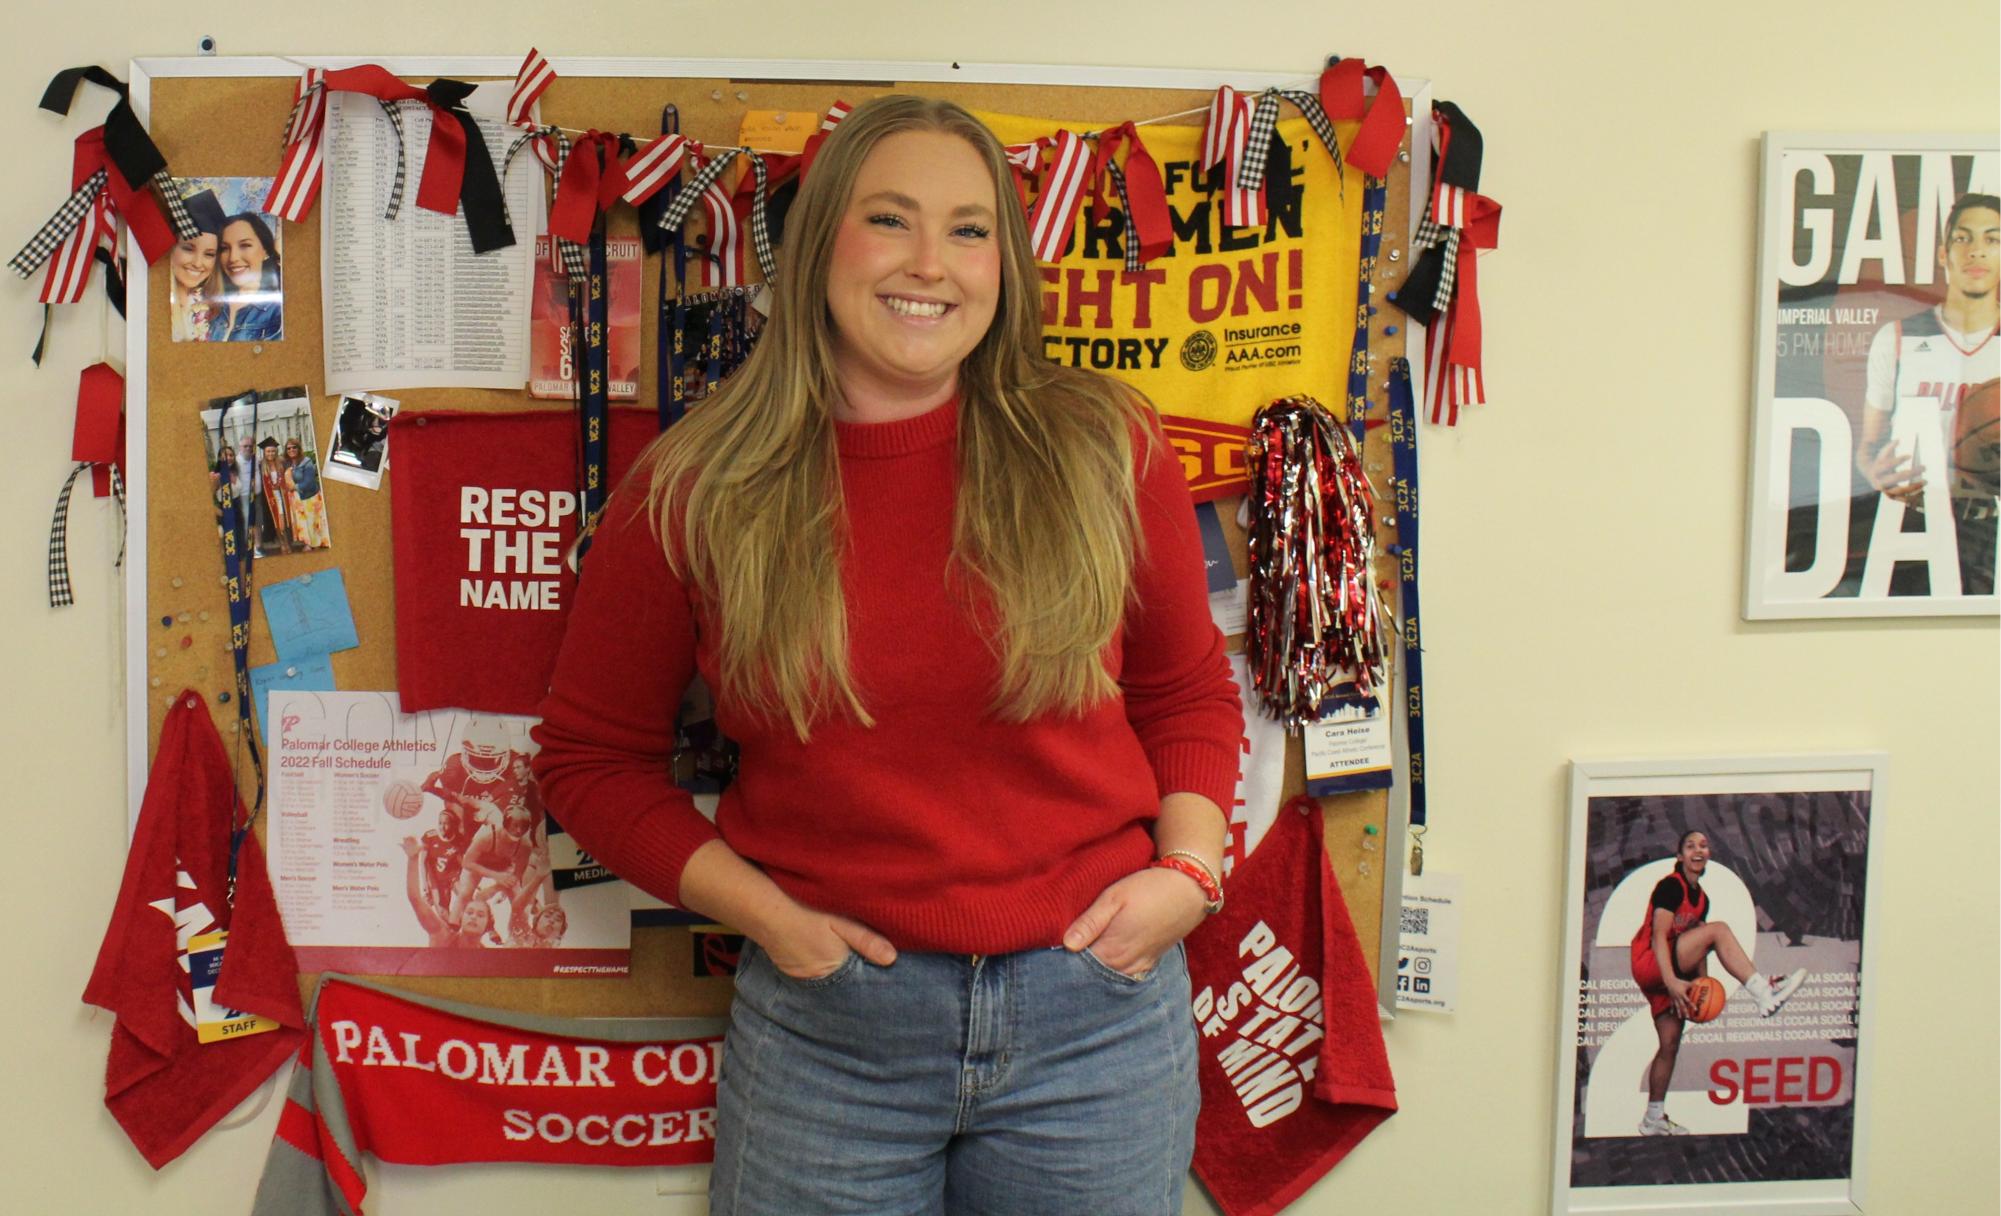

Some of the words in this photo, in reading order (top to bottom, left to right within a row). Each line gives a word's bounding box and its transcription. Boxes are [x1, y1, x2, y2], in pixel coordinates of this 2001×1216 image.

[1187, 248, 1303, 325] ON!
[1777, 308, 1833, 325] IMPERIAL
[1835, 308, 1879, 325] VALLEY
[1224, 323, 1301, 342] Insurance
[1776, 333, 1788, 357] 5
[1793, 332, 1820, 356] PM
[1825, 332, 1872, 356] HOME
[1225, 345, 1301, 364] AAA.com
[1391, 409, 1405, 443] 3C2A
[460, 486, 587, 528] RESP
[1397, 478, 1409, 513] 3C2A
[460, 528, 561, 575] THE
[1403, 547, 1416, 582] 3C2A
[459, 578, 561, 611] NAME
[1406, 616, 1418, 651] 3C2A
[1410, 685, 1421, 718] 3C2A
[281, 738, 331, 751] Palomar
[333, 738, 380, 754] College
[382, 738, 437, 752] Athletics
[280, 756, 310, 769] 2022
[312, 756, 333, 769] Fall
[335, 756, 392, 770] Schedule
[1329, 757, 1370, 769] ATTENDEE
[1412, 752, 1423, 784] 3C2A
[436, 857, 448, 873] 5
[573, 867, 613, 881] MEDIA
[1823, 971, 1855, 983] SOCAL
[1822, 985, 1855, 997] SOCAL
[1821, 999, 1854, 1012] SOCAL
[222, 1020, 257, 1034] STAFF
[1726, 1016, 1783, 1028] REGIONALS
[1820, 1013, 1854, 1025] SOCAL
[1693, 1031, 1724, 1044] SOCAL
[1726, 1029, 1783, 1042] REGIONALS
[1820, 1026, 1852, 1039] SOCAL
[331, 1019, 615, 1088] PALOMAR
[1216, 1037, 1304, 1129] MIND
[1707, 1055, 1843, 1107] SEED
[502, 1106, 717, 1148] SOCCER
